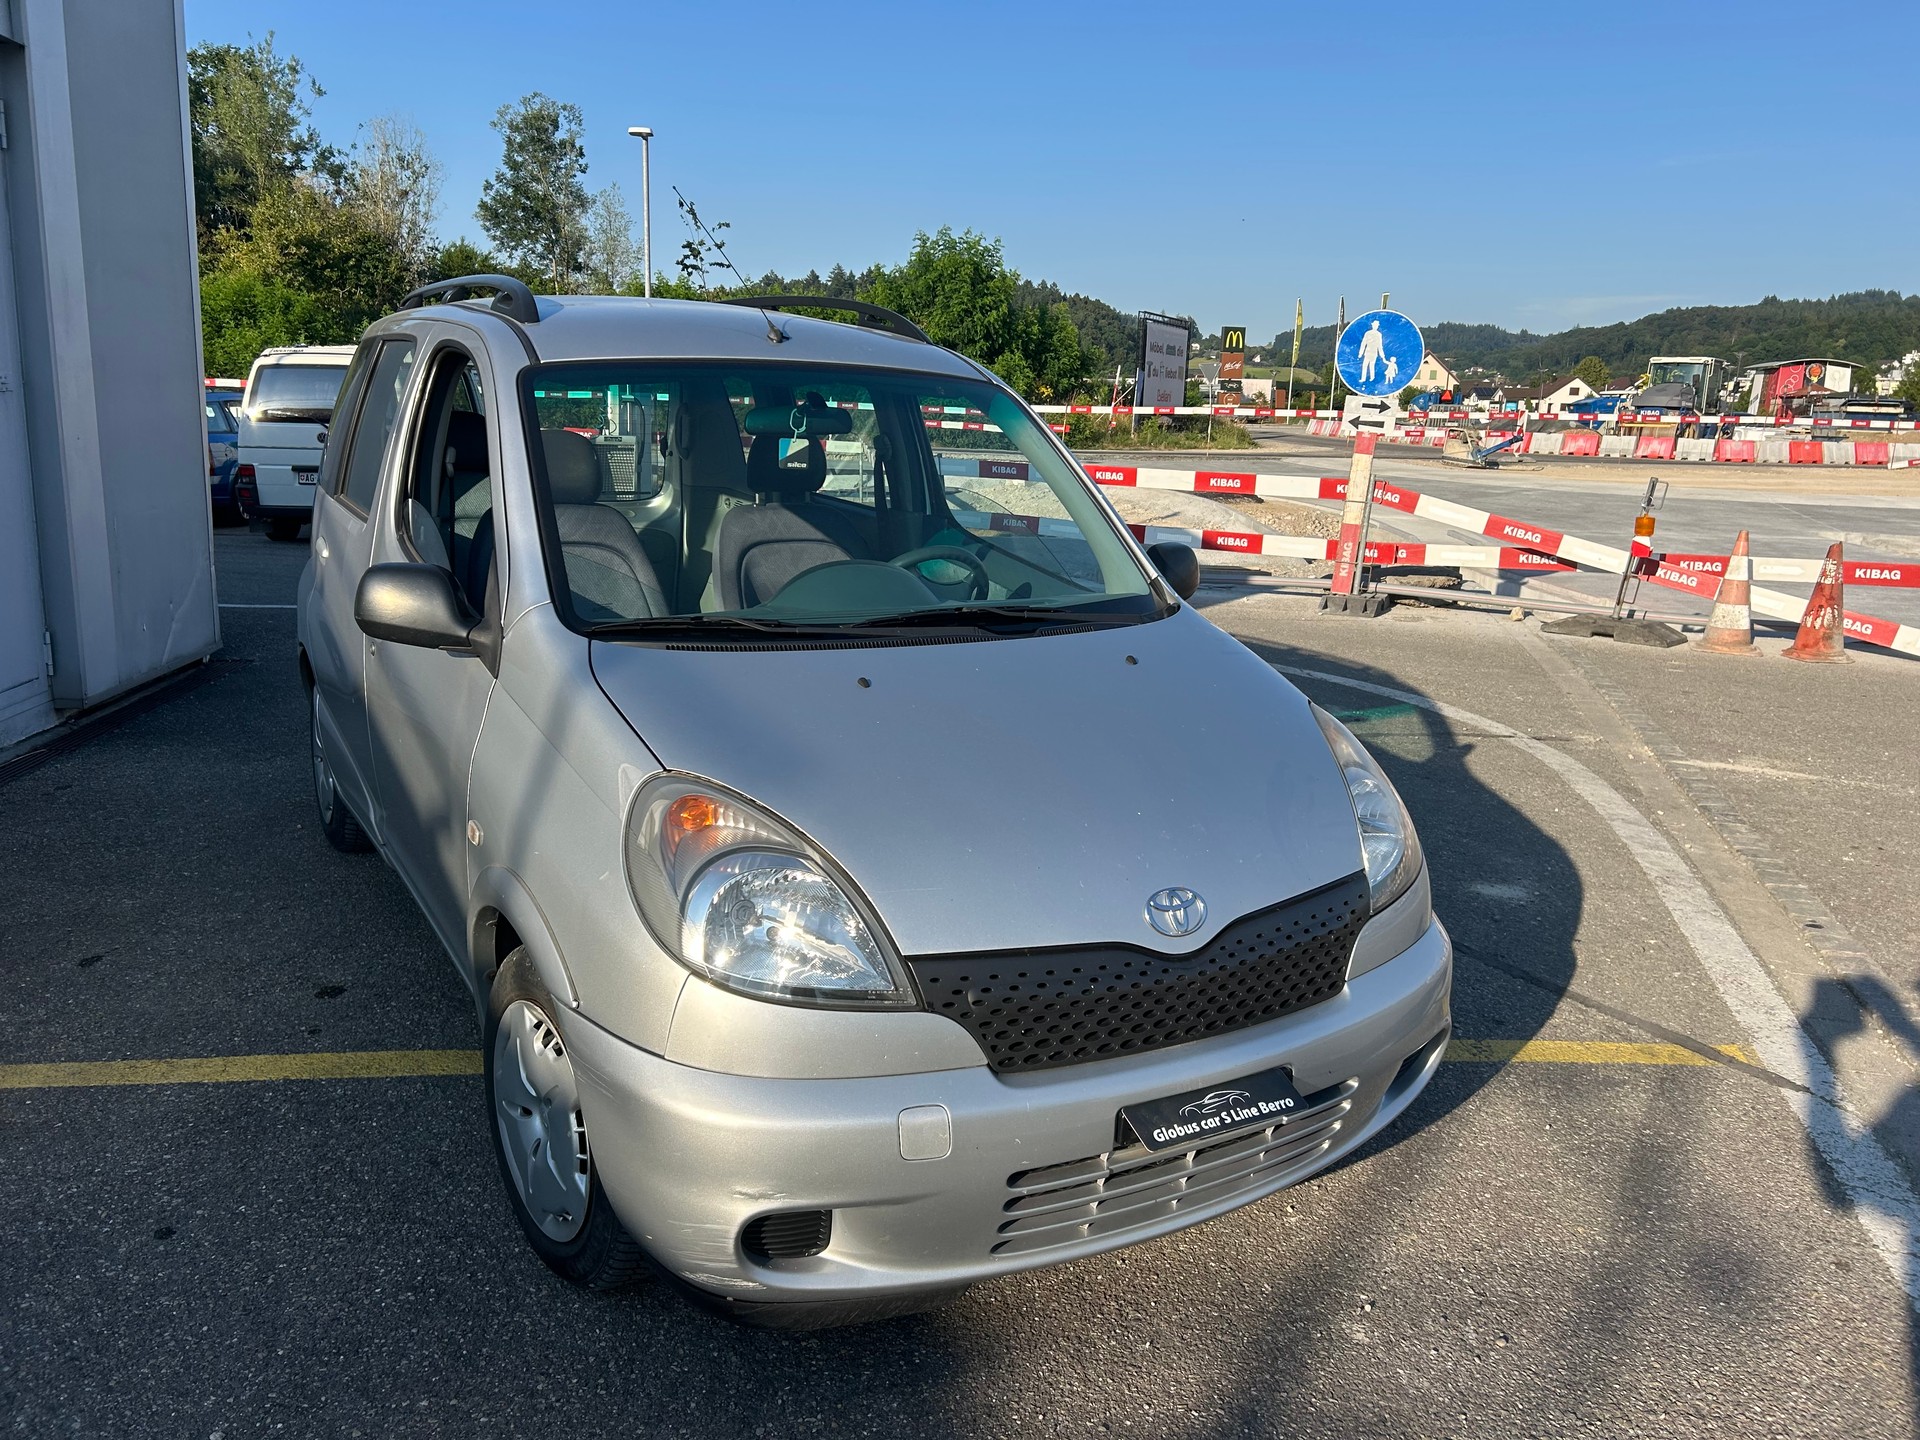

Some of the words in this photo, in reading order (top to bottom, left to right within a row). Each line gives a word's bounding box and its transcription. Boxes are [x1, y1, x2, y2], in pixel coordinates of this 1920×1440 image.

[992, 466, 1016, 474] KIBAG
[1096, 472, 1124, 480] KIBAG
[1210, 478, 1240, 488] KIBAG
[1374, 488, 1400, 503] IBAG
[1504, 525, 1542, 543] KIBAG
[1217, 536, 1248, 546] KIBAG
[1340, 542, 1354, 576] KIBAG
[1519, 554, 1558, 564] KIBAG
[1680, 561, 1722, 572] KIBAG
[1656, 568, 1698, 587] KIBAG
[1855, 568, 1901, 580] KIBAG
[1844, 618, 1873, 634] BAG
[1153, 1124, 1200, 1142] Globus
[1200, 1117, 1220, 1130] car
[1220, 1112, 1232, 1124] S
[1230, 1106, 1258, 1122] Line
[1258, 1097, 1294, 1114] Berro
